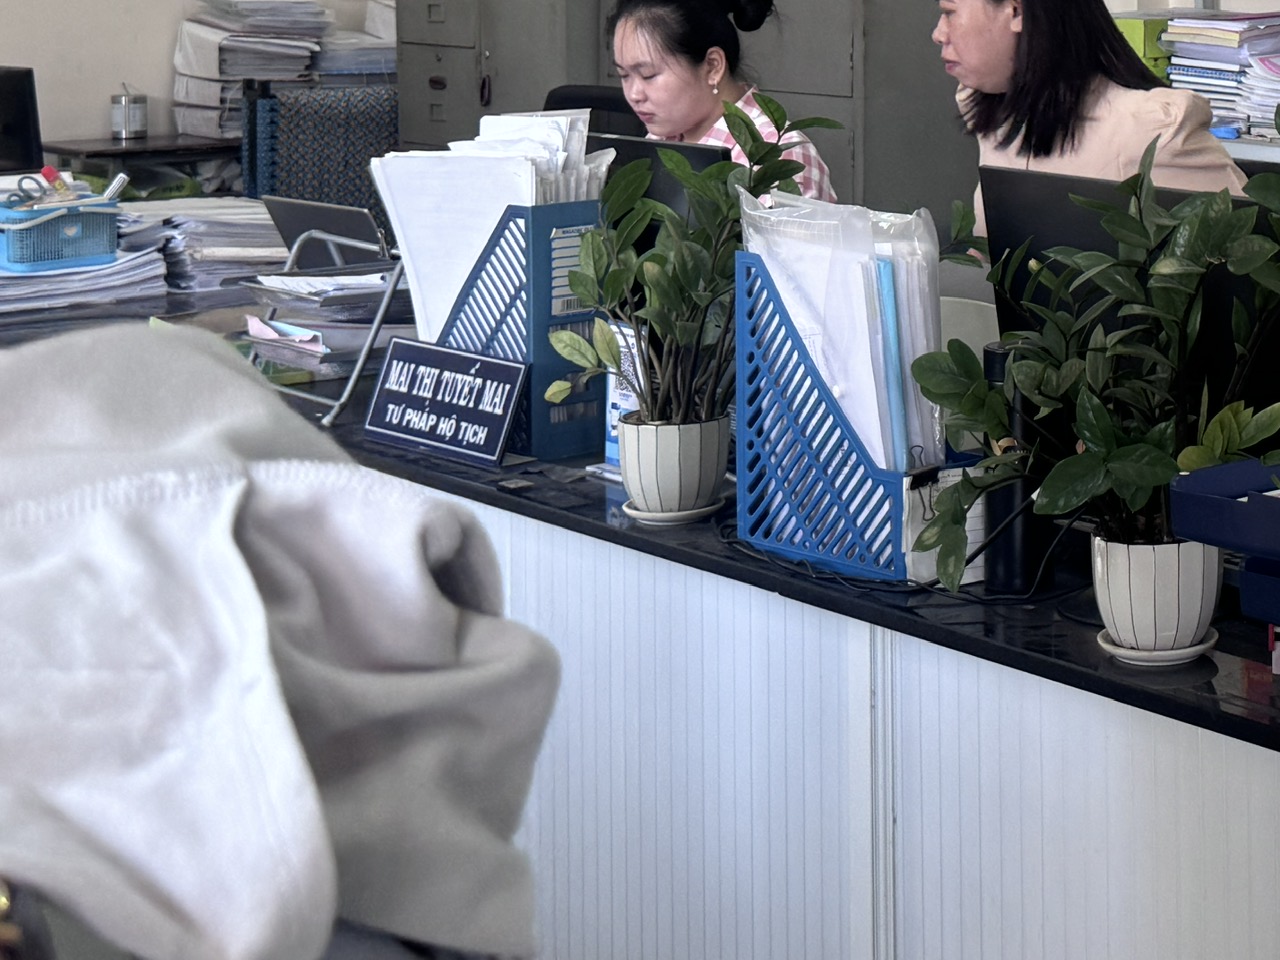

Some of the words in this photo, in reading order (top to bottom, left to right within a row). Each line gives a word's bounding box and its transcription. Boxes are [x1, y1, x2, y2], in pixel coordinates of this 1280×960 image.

[384, 360, 416, 393] MAI
[436, 361, 483, 409] TUYẾT
[478, 380, 511, 416] MAI
[384, 403, 405, 425] TƯ
[402, 406, 437, 432] PHÁP
[436, 414, 458, 441] HỘ
[459, 421, 489, 446] TỊCH
